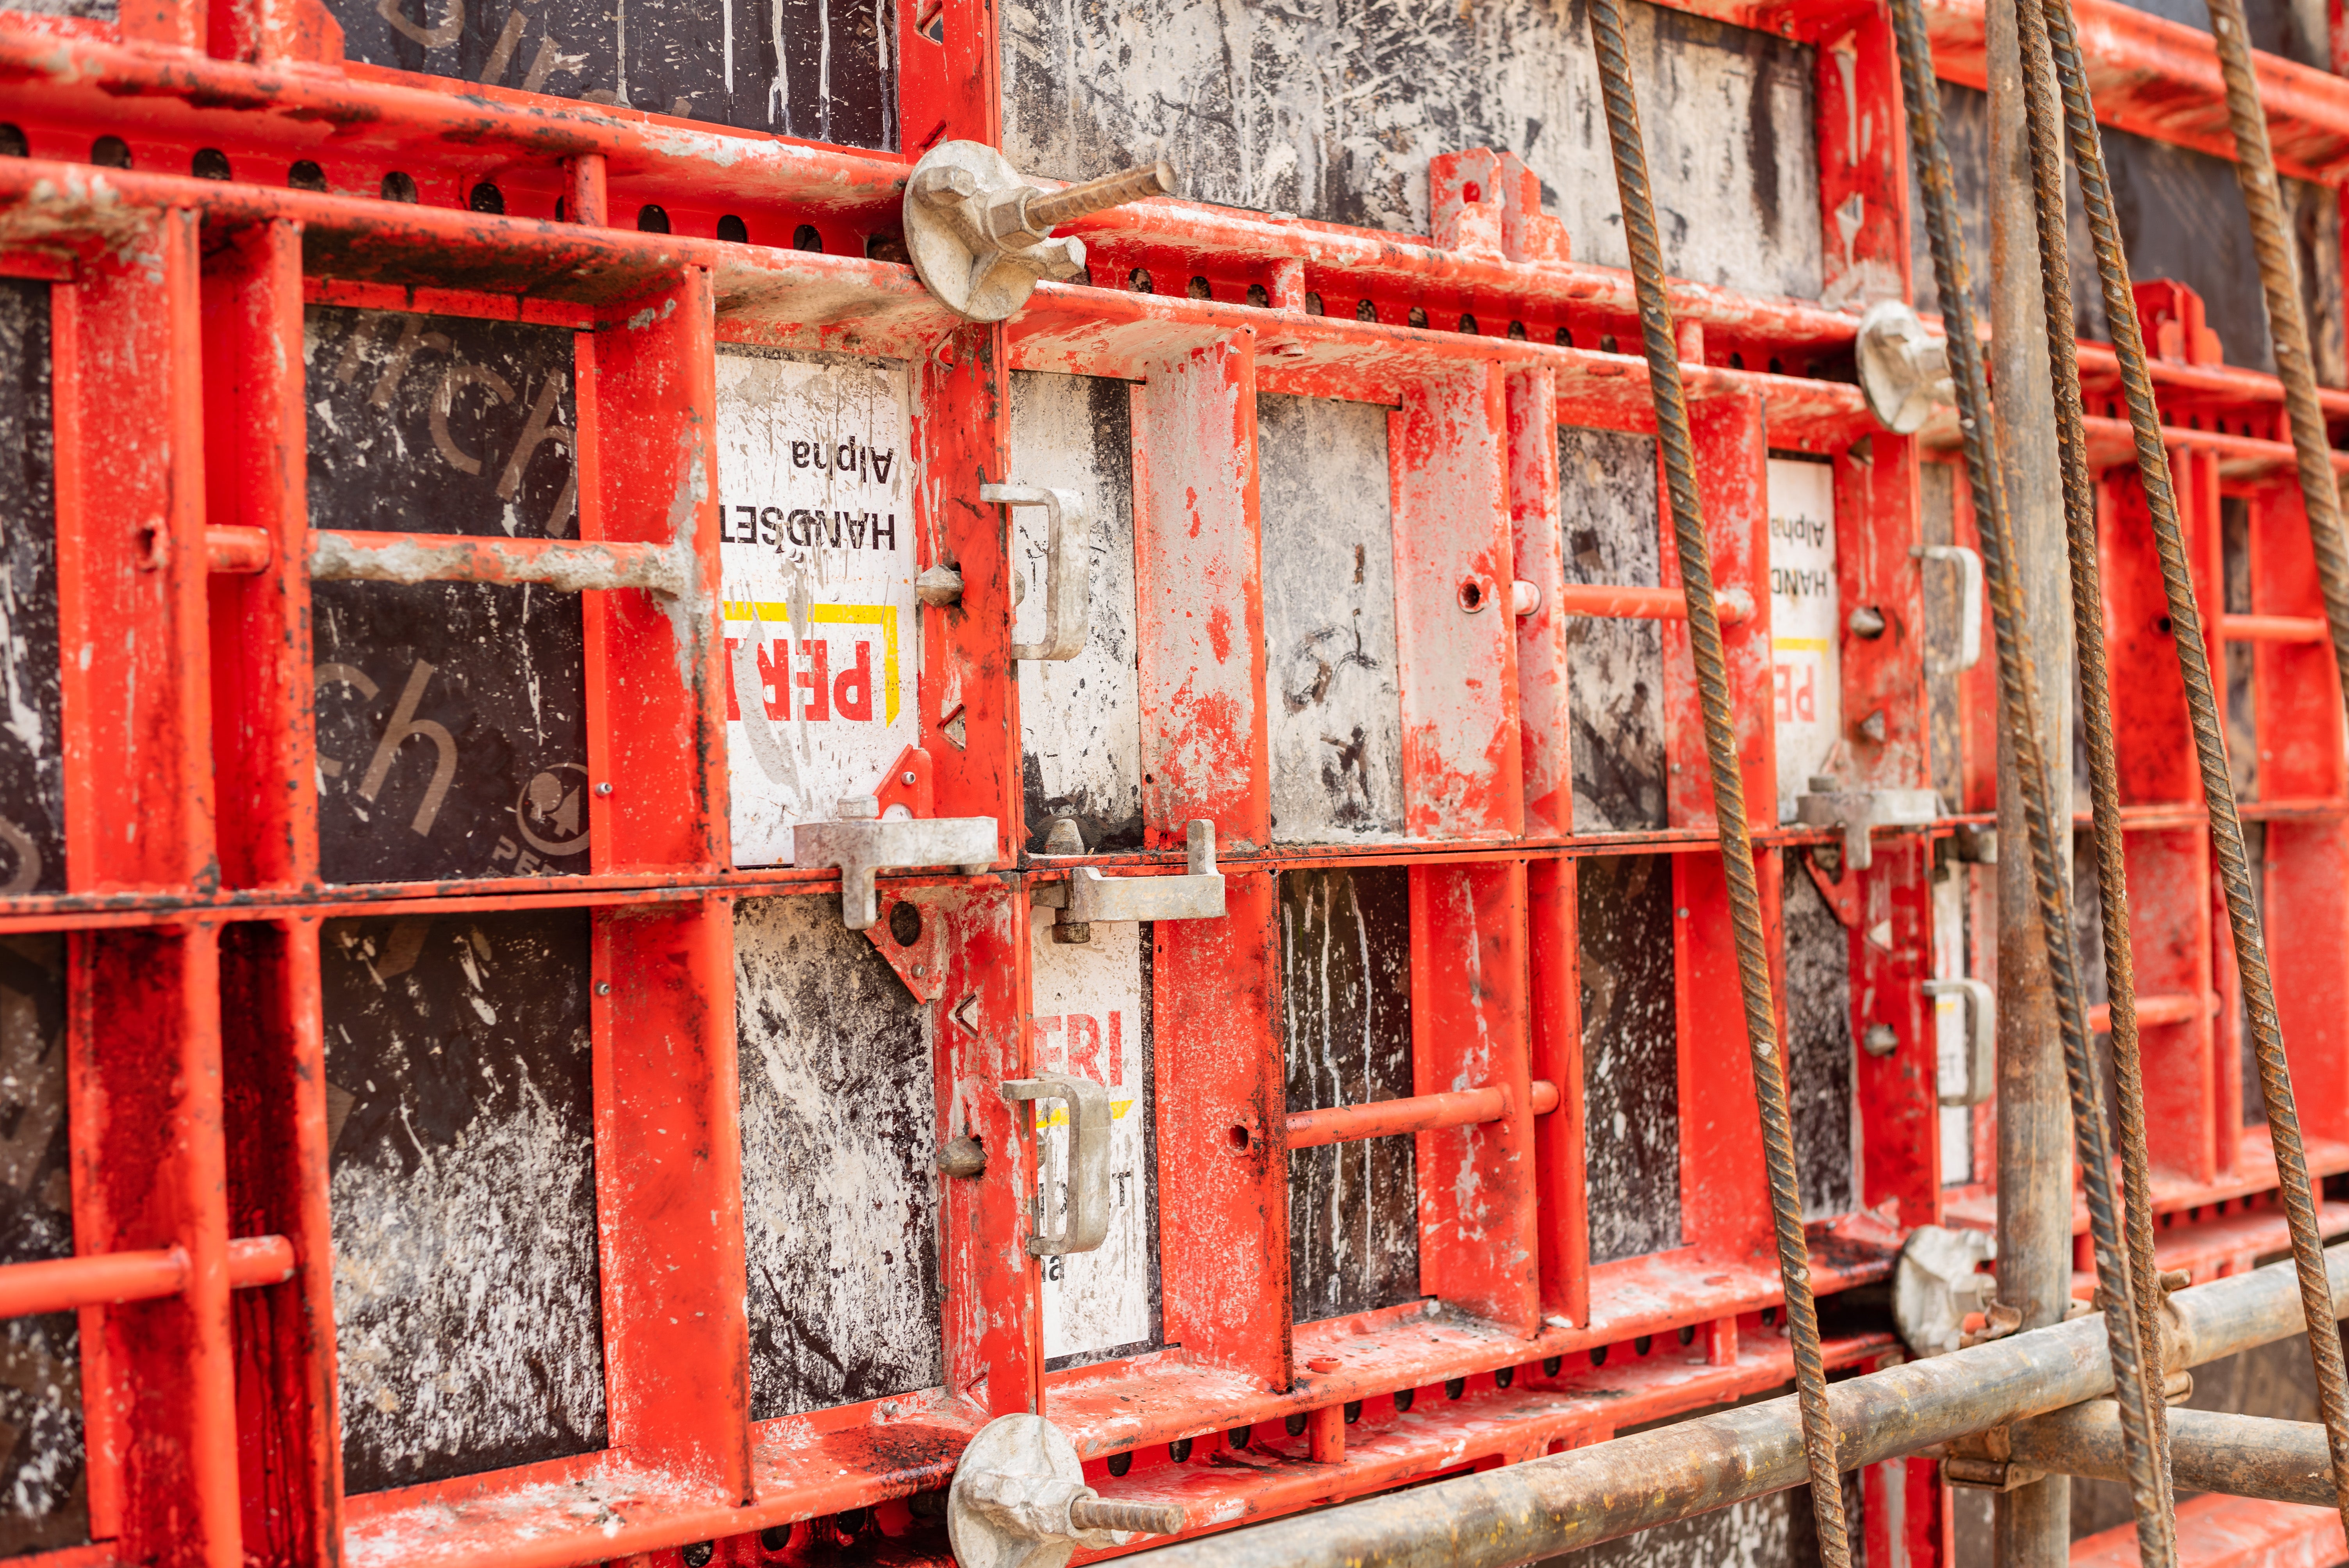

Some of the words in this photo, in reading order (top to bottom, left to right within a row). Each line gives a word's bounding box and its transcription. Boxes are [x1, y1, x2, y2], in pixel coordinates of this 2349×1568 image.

[791, 435, 894, 484] Alpha
[720, 504, 895, 551] HANDSET
[1771, 513, 1825, 548] Alpha
